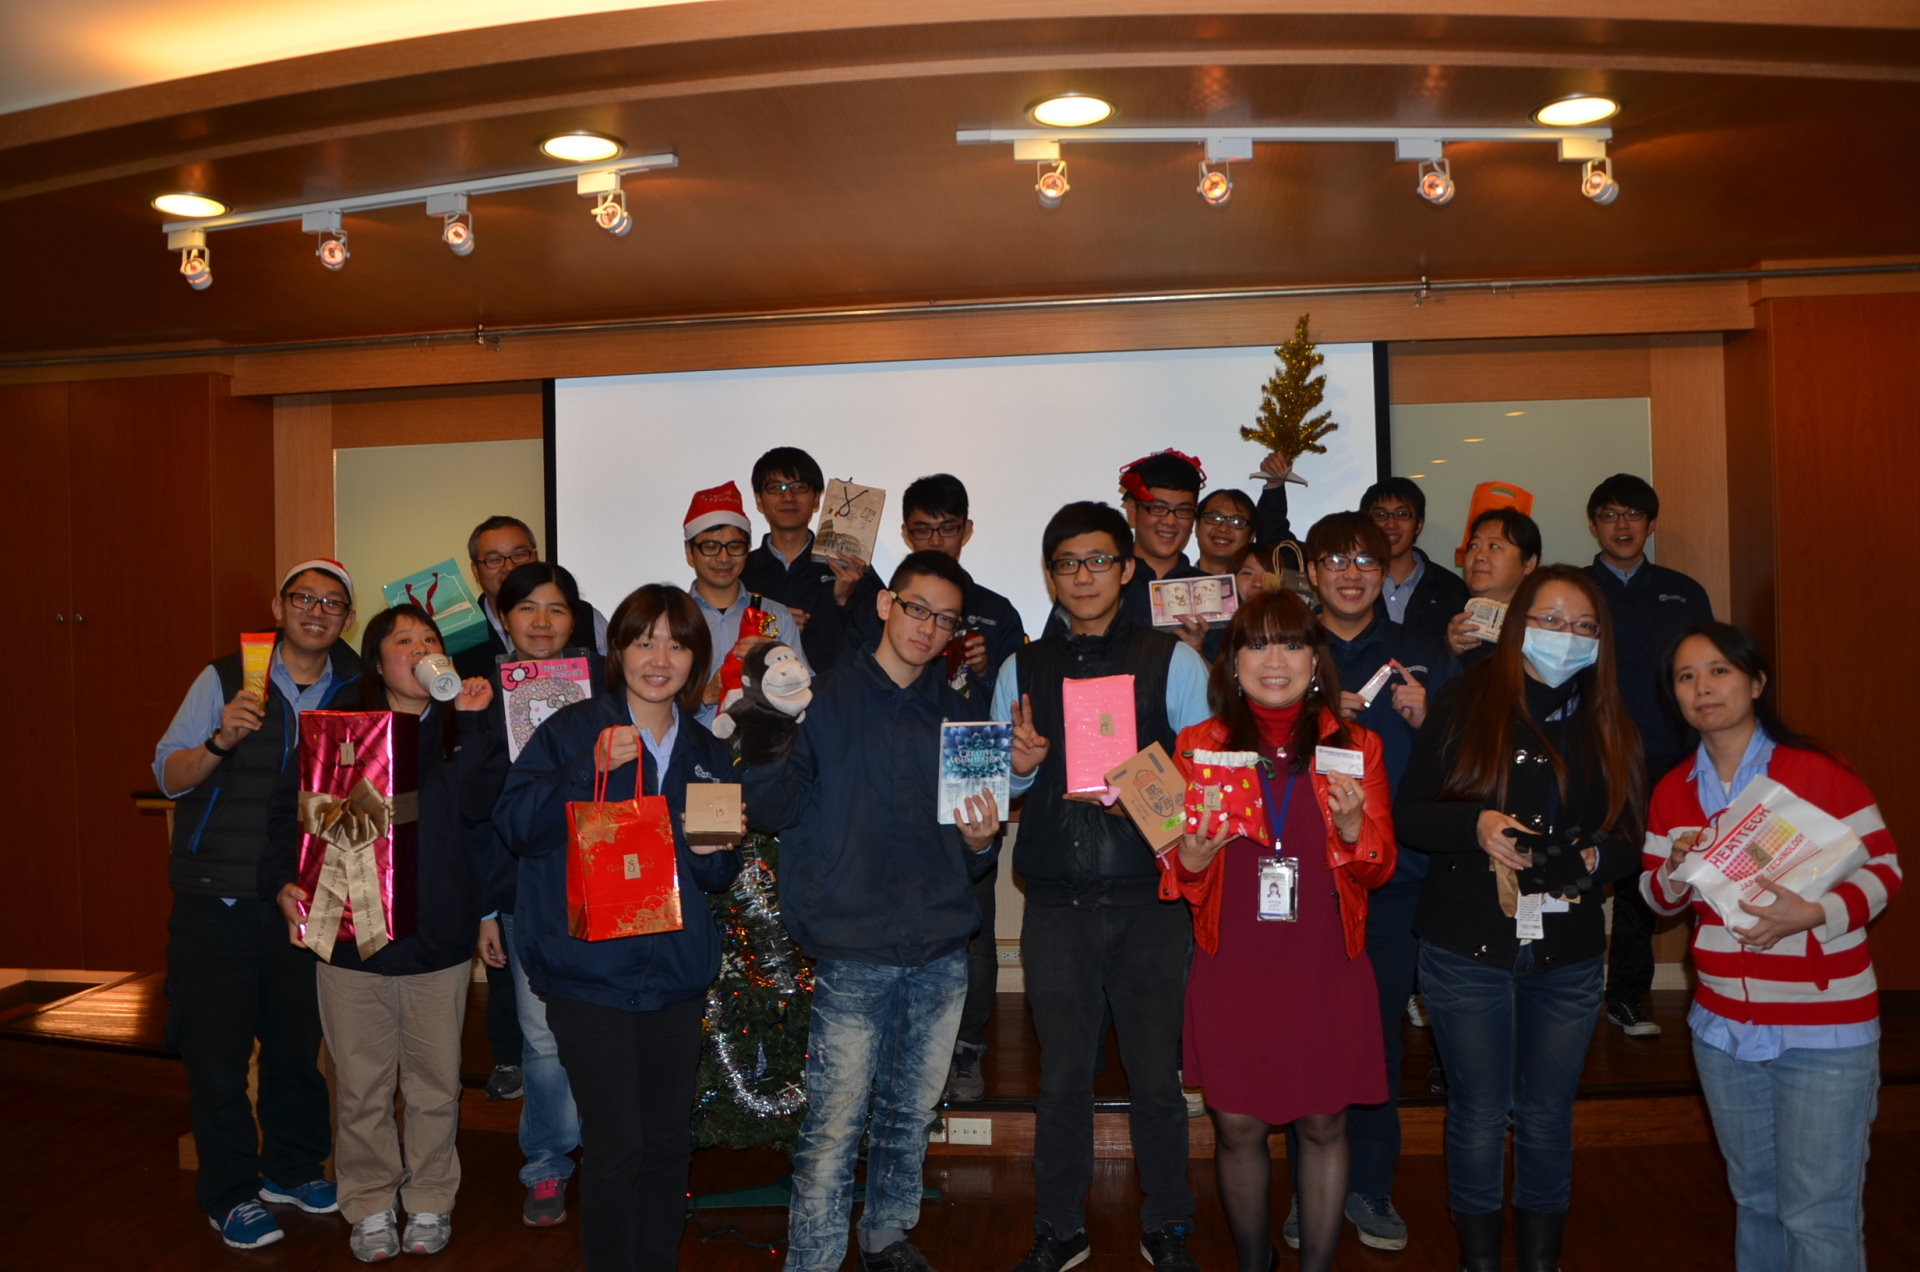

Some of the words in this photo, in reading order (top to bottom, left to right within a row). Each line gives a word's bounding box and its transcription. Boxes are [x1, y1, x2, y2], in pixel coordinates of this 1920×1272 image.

[959, 749, 994, 758] CREATIVE
[715, 808, 725, 818] 15
[1708, 807, 1771, 869] HEATTECH
[1766, 832, 1806, 873] TECHNOLOGY
[627, 859, 637, 873] 8
